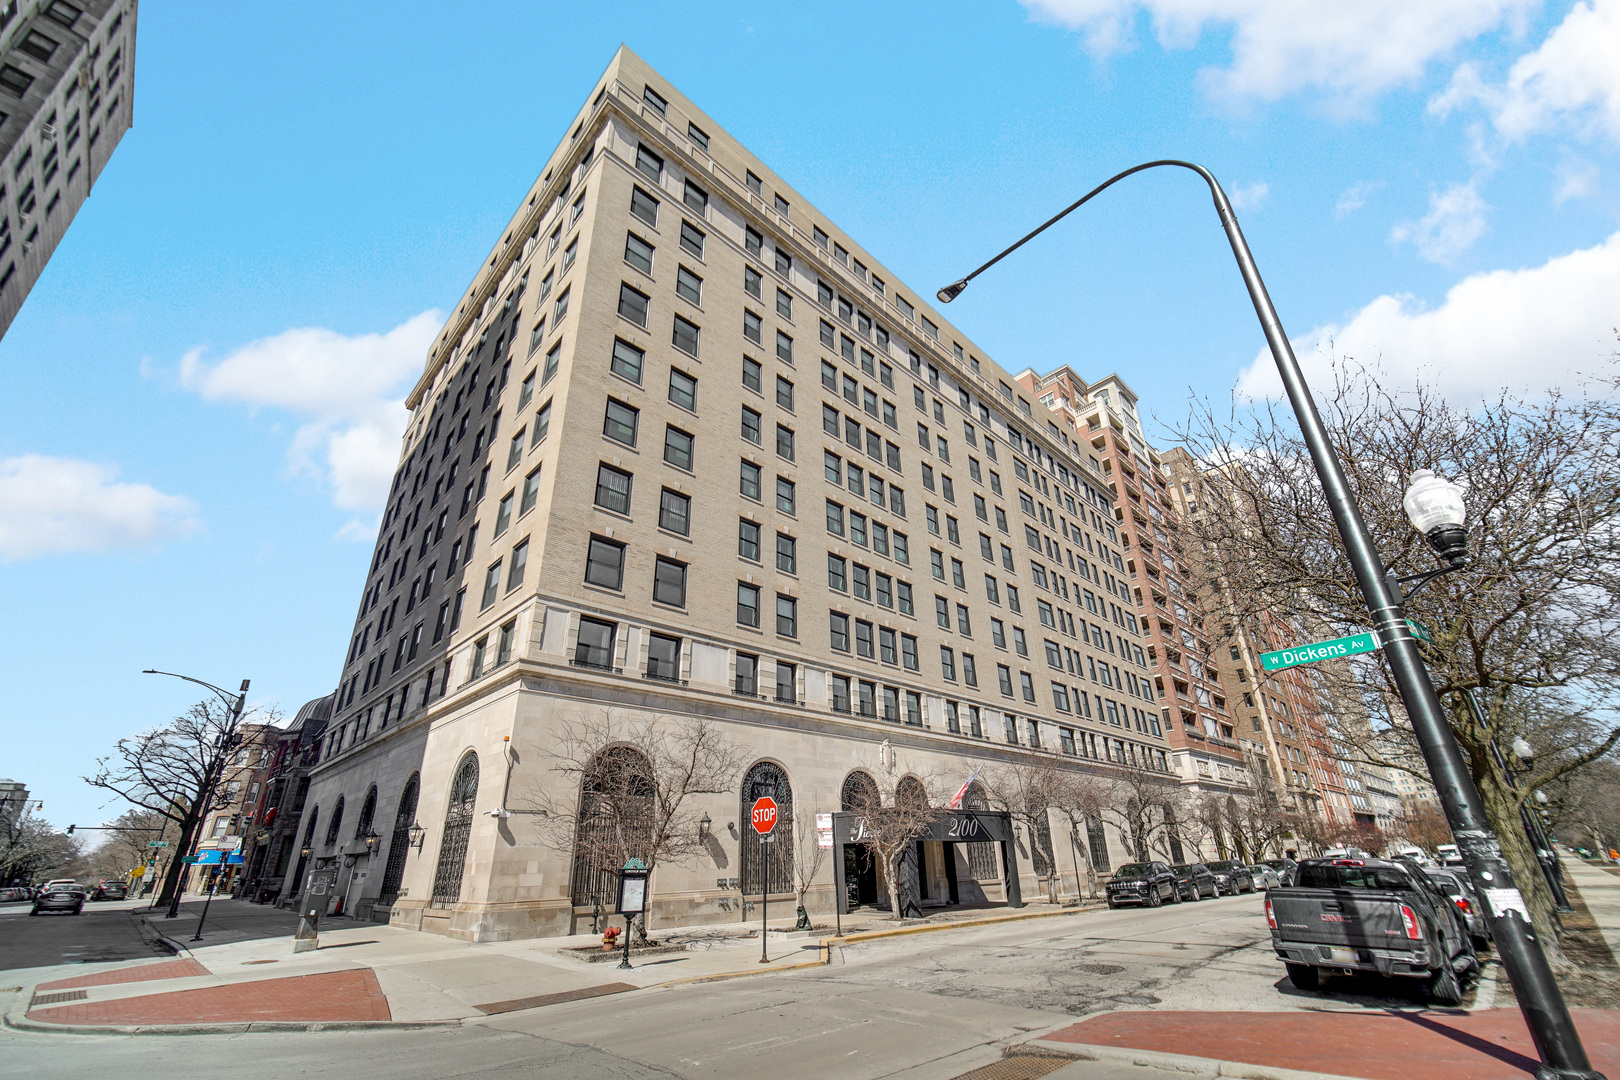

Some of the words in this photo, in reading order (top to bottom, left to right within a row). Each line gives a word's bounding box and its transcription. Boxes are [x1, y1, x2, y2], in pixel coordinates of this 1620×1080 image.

[1283, 643, 1347, 664] Dickens
[1351, 640, 1364, 649] Av
[753, 807, 776, 823] STOP
[948, 817, 978, 837] 2100
[1320, 914, 1352, 923] GMC
